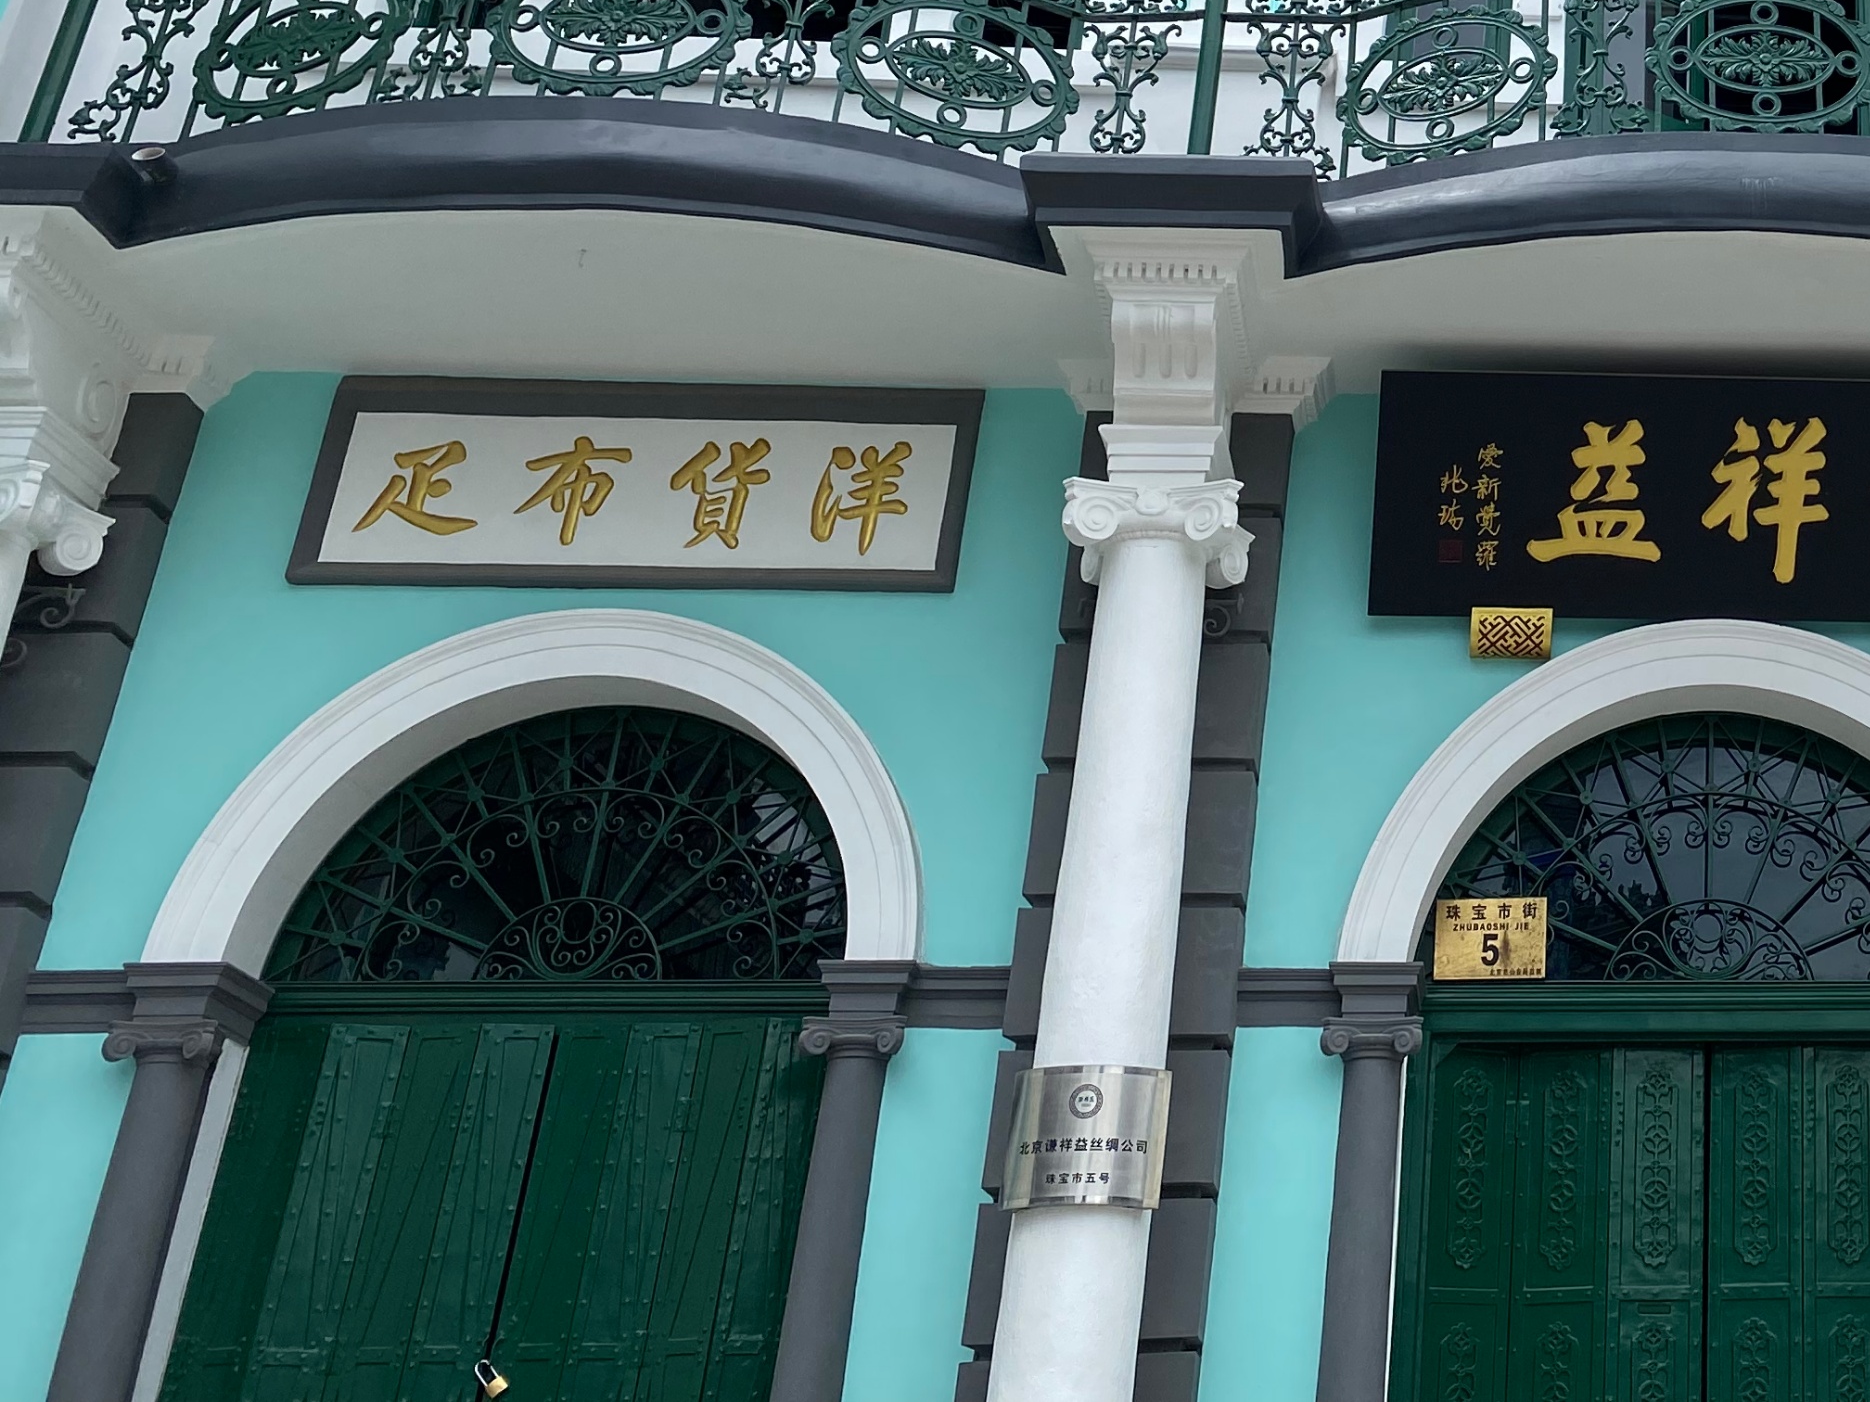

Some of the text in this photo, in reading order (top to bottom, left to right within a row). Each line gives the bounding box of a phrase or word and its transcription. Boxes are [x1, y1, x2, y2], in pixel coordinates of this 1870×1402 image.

[1445, 902, 1538, 921] 珠宝市街
[1452, 921, 1530, 932] ZHUBAOSHI JIE
[1480, 933, 1500, 967] 5
[1044, 1171, 1111, 1185] 珠宝市五号
